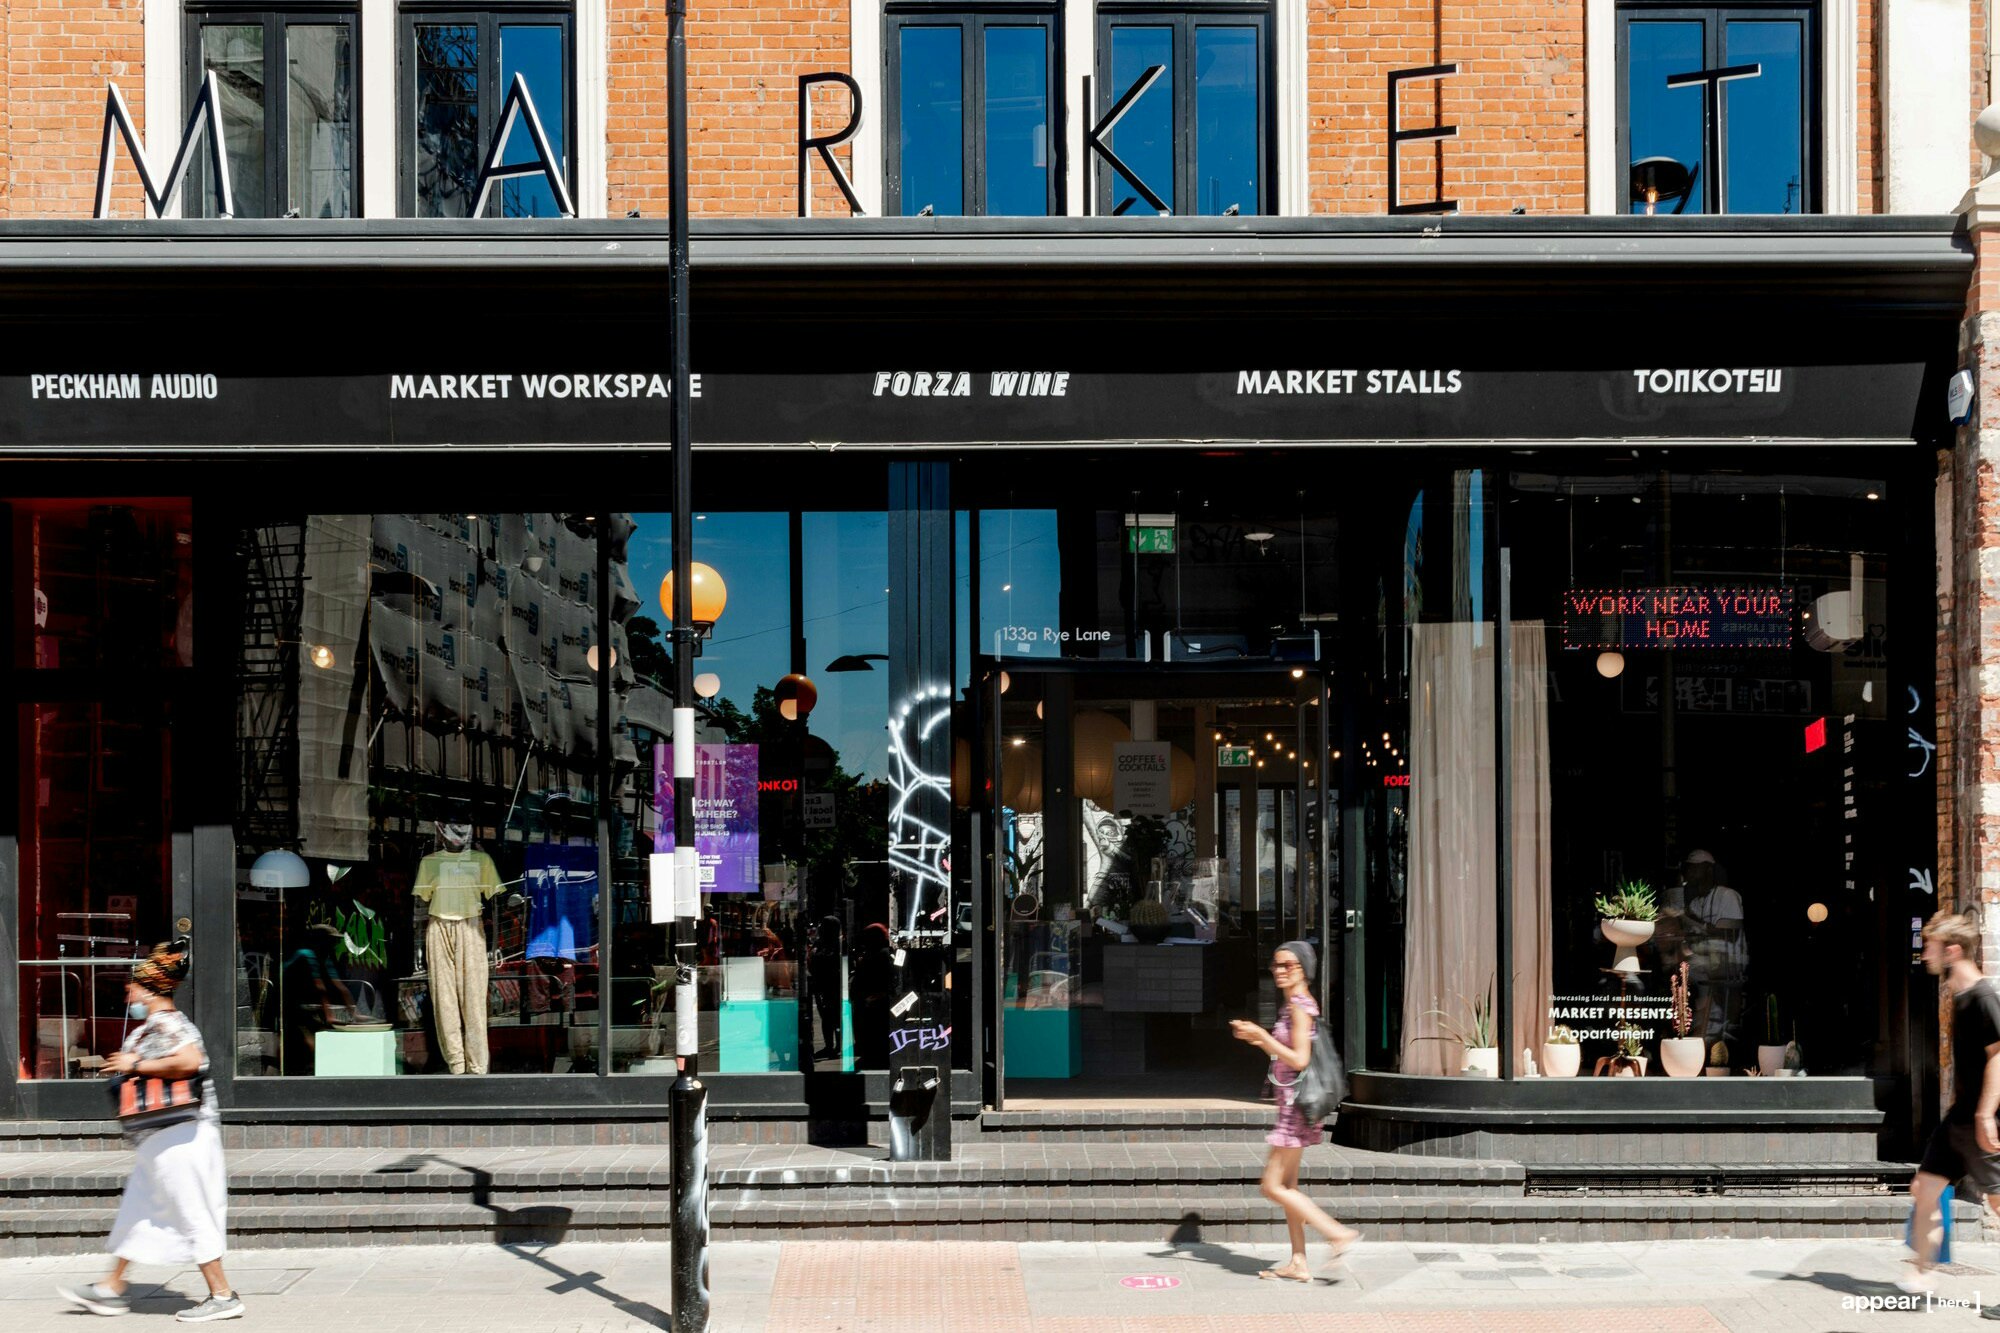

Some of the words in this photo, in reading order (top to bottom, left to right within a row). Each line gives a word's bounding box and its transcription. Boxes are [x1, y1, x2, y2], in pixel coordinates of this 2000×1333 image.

[94, 63, 1761, 219] MARKET
[31, 374, 140, 400] PECKHAM
[151, 374, 218, 400] AUDIO
[390, 374, 513, 399] MARKET
[521, 373, 702, 399] WORKSPAE
[872, 371, 971, 398] FORZA
[990, 371, 1071, 397] WINE
[1237, 369, 1357, 395] MARKET
[1367, 369, 1463, 394] STALLS
[1633, 368, 1782, 394] TONKOTSU
[1572, 596, 1646, 614] WORK
[1653, 596, 1712, 614] NEAR
[1718, 596, 1783, 614] YOUR
[1003, 627, 1038, 641] 133a
[1043, 627, 1070, 644] Rye
[1076, 627, 1111, 641] Lane
[1646, 620, 1711, 638] HOME
[1118, 754, 1156, 764] COFFEE
[1118, 763, 1167, 772] COCKTAILS
[1383, 775, 1410, 786] FORZ
[714, 799, 735, 807] WAY
[1592, 994, 1609, 1002] local
[1612, 994, 1631, 1002] small
[1634, 994, 1673, 1002] businesses
[1549, 1008, 1604, 1019] MARKET
